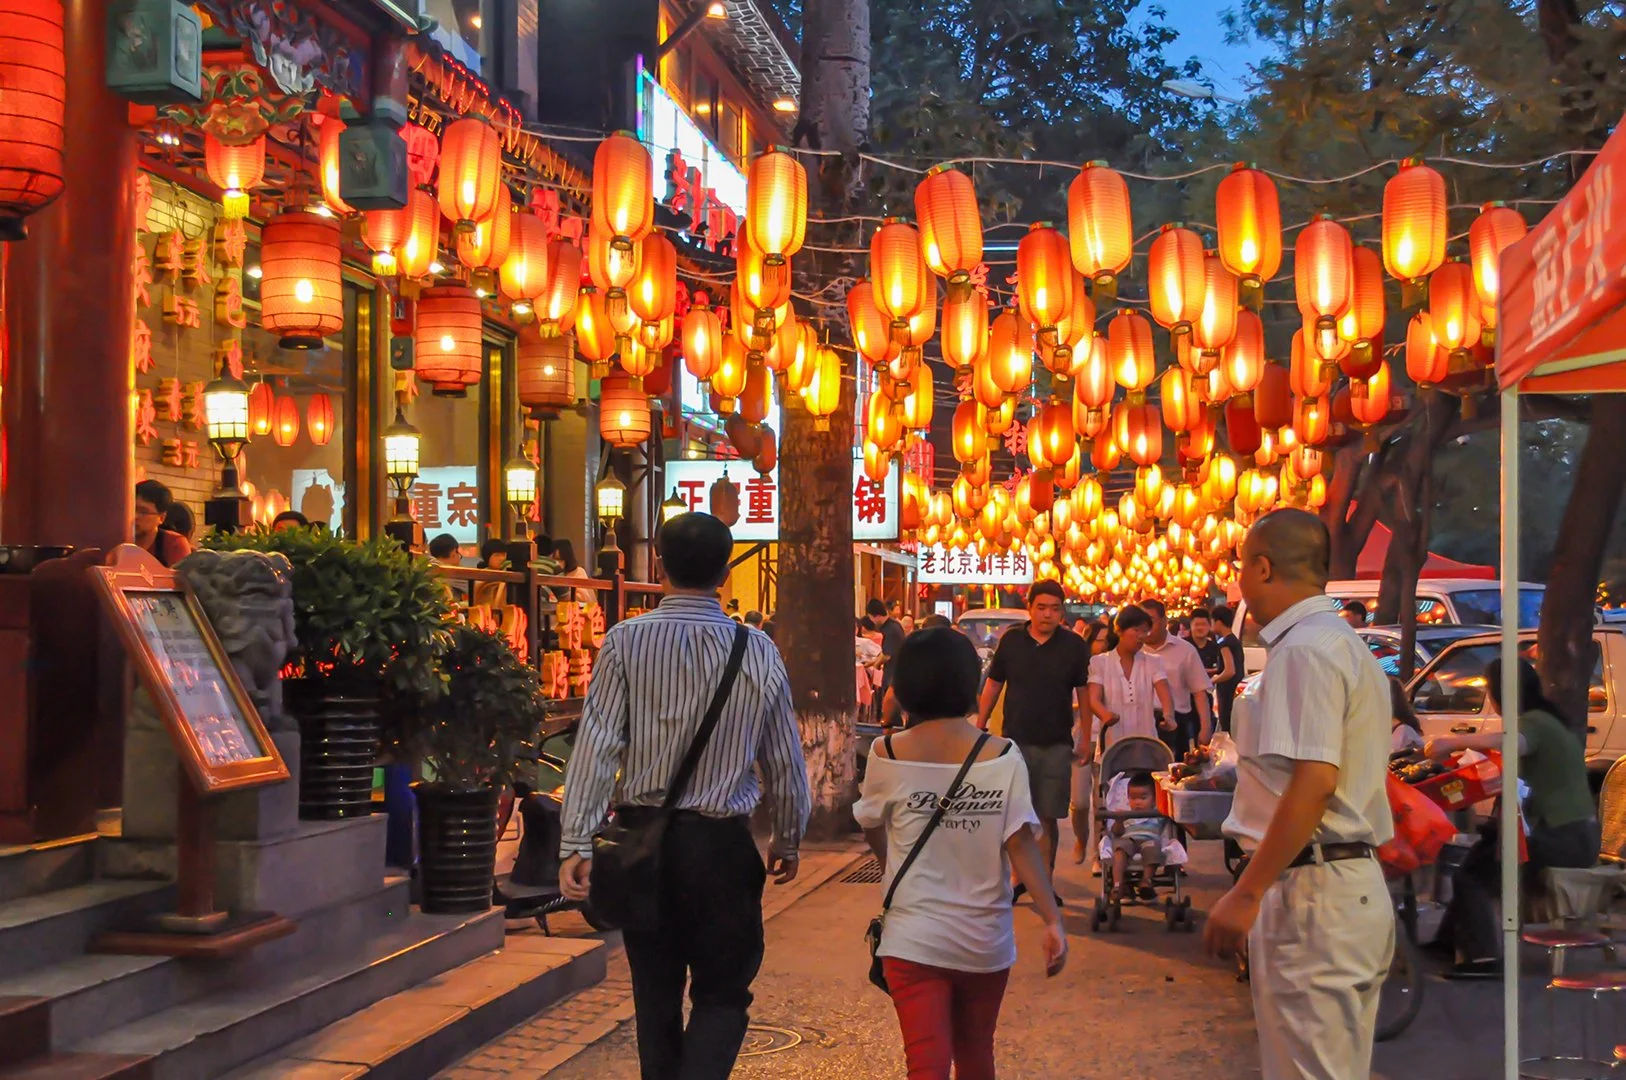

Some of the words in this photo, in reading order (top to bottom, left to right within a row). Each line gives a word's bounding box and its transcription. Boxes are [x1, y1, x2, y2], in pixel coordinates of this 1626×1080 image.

[172, 438, 200, 468] 3元
[957, 782, 1004, 799] Dom
[941, 818, 981, 833] arty
